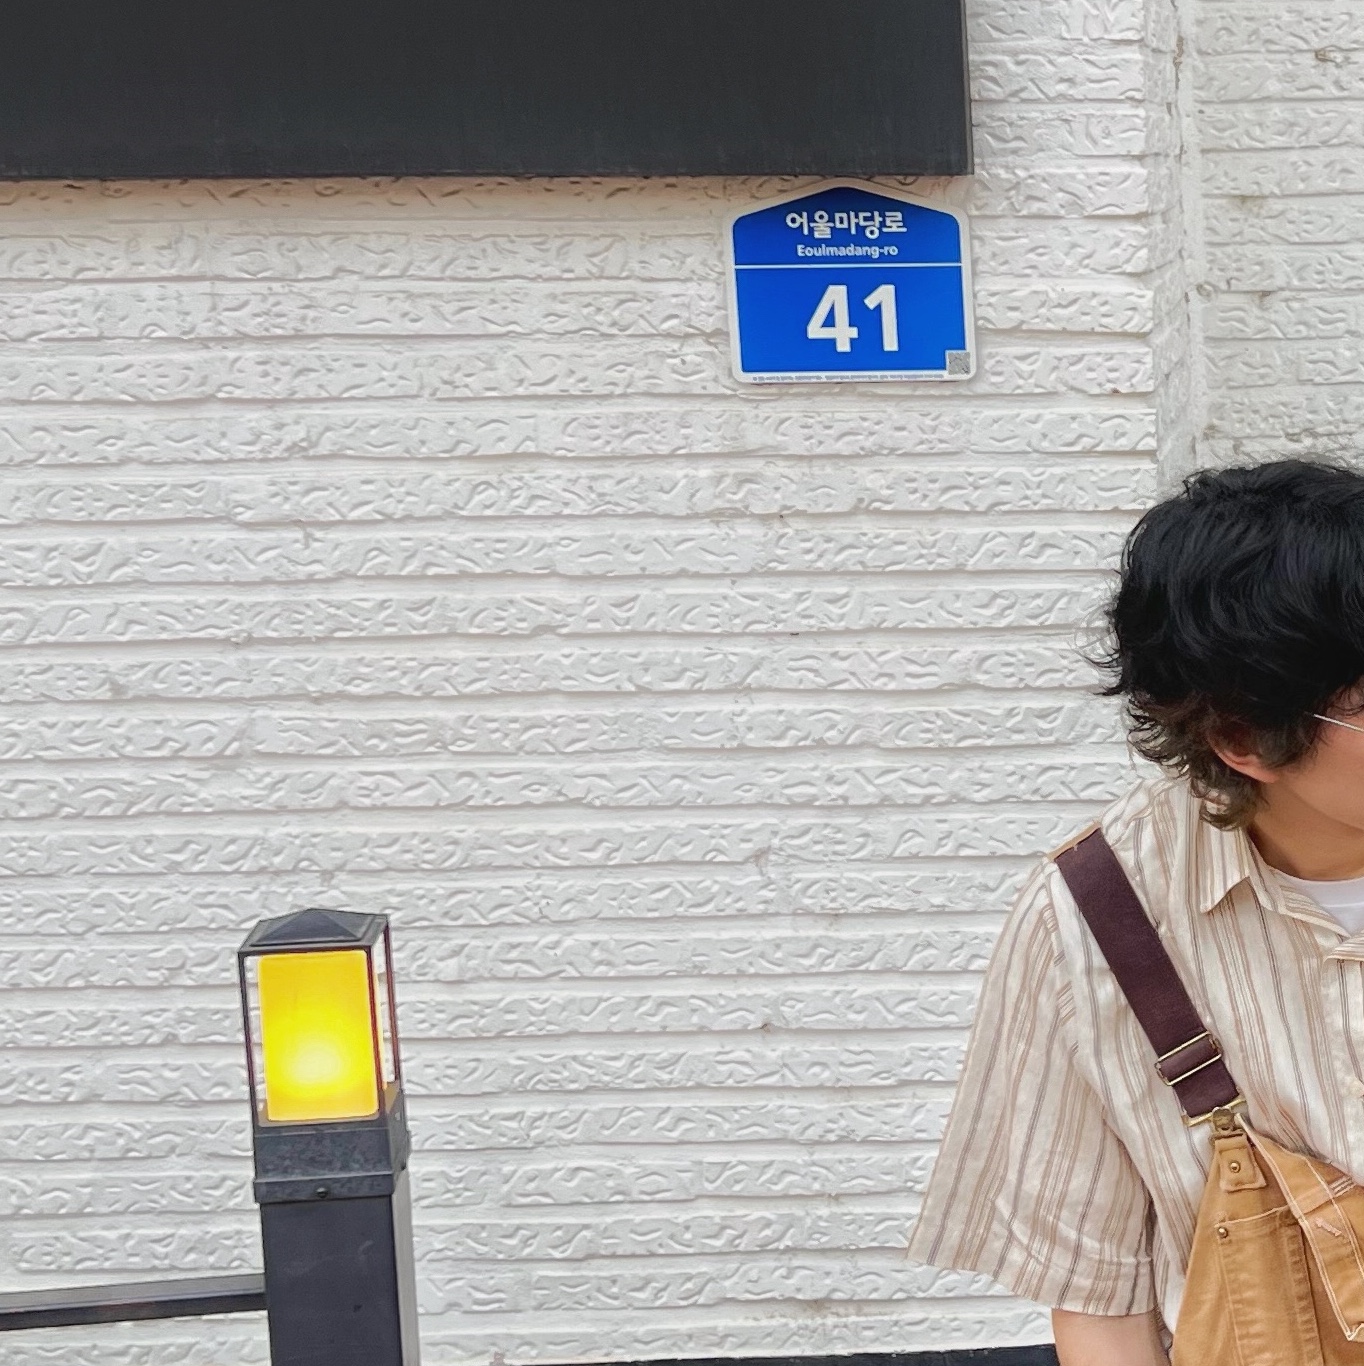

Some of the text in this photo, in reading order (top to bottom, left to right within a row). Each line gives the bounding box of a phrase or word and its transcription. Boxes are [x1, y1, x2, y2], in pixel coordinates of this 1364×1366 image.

[785, 210, 907, 239] 어울마당로
[796, 243, 899, 259] Eoulmadang-ro
[806, 283, 899, 352] 41
